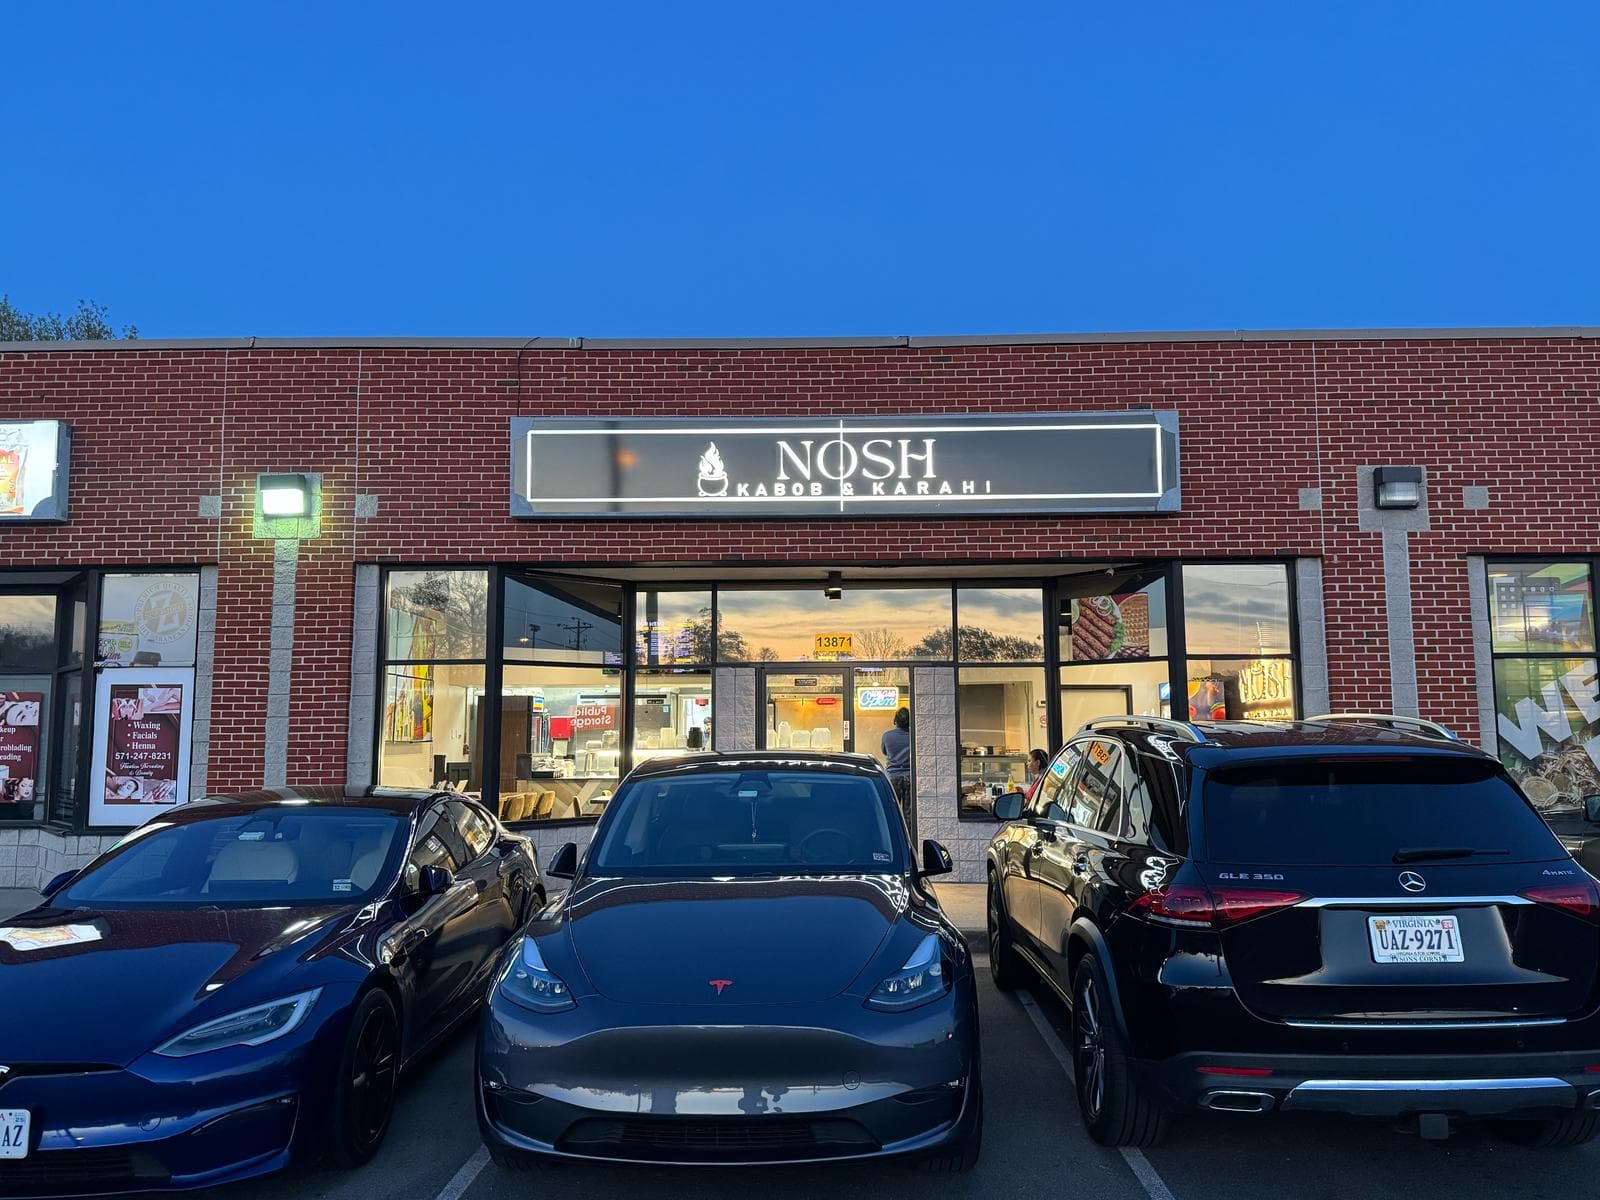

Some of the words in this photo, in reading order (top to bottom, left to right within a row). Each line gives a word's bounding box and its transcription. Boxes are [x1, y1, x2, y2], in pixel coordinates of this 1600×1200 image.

[776, 438, 937, 481] NOSH
[736, 482, 824, 497] KABOB
[840, 482, 854, 496] &
[872, 479, 992, 496] KARAHI
[816, 636, 853, 648] 13871
[861, 690, 896, 708] Open
[133, 721, 161, 731] Waxing
[132, 731, 158, 740] Facials
[132, 741, 156, 750] Henna
[1219, 872, 1250, 880] GLE
[1253, 873, 1284, 881] 350
[1391, 919, 1435, 928] VIRGINIA
[1379, 929, 1455, 950] UAZ-9271
[1, 1125, 24, 1146] AZ
